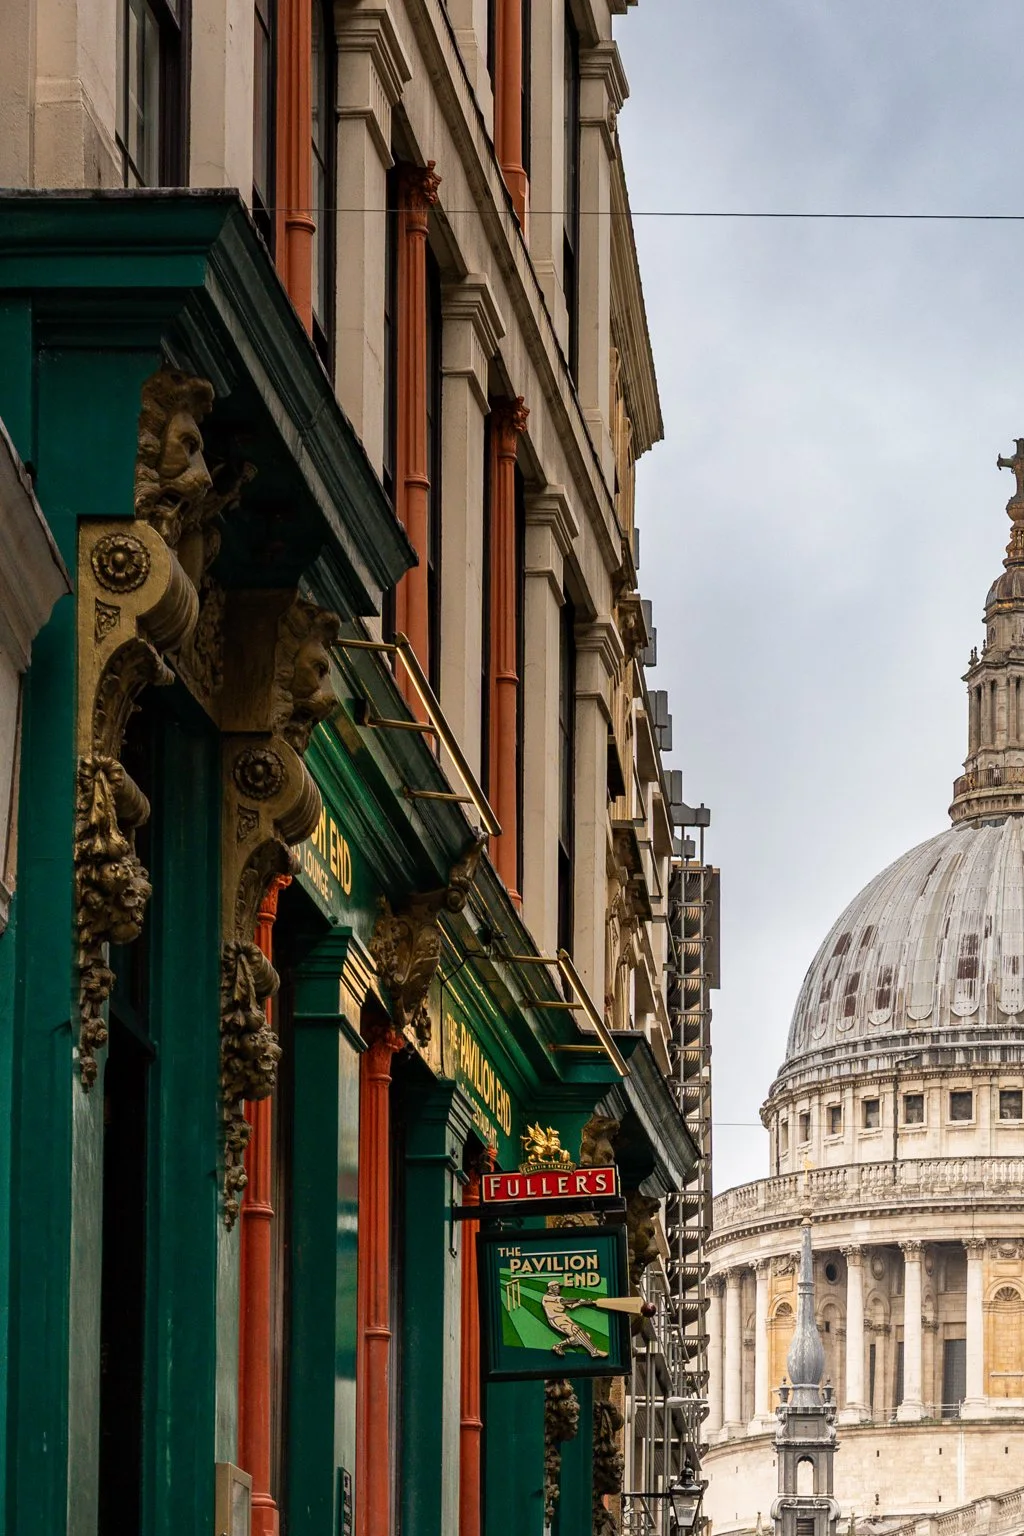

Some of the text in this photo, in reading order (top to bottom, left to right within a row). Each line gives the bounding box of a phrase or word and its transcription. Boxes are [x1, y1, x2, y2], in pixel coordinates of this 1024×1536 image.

[330, 817, 352, 895] END
[461, 1022, 495, 1114] PAVILION
[496, 1077, 511, 1137] END
[490, 1171, 607, 1198] FULLER'S
[498, 1247, 521, 1257] THE
[510, 1254, 598, 1273] PAVILION
[564, 1272, 601, 1287] END
